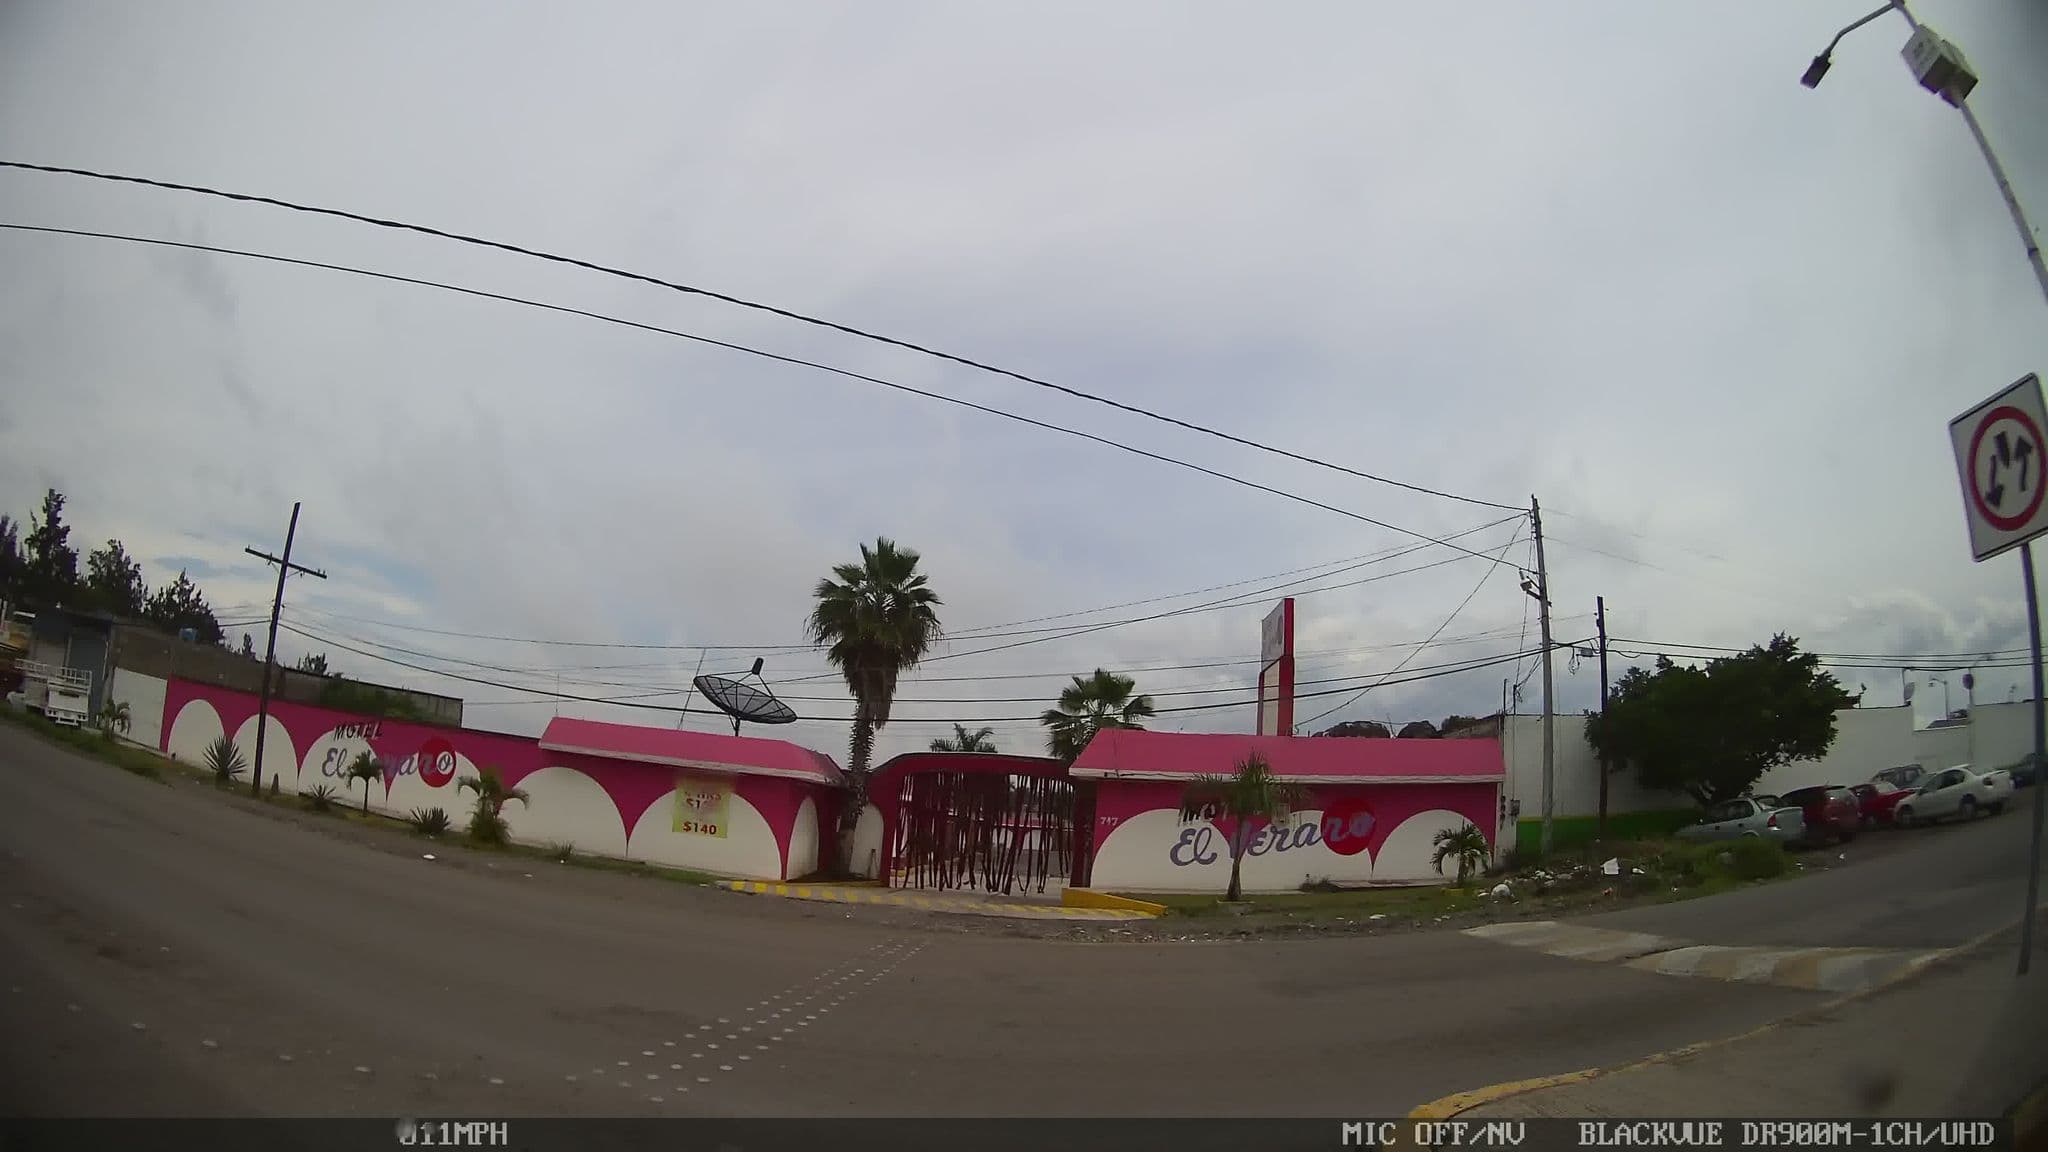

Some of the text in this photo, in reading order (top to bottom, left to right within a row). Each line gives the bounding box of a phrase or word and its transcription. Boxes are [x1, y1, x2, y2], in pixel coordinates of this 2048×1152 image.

[333, 721, 383, 741] MOTEL
[322, 748, 348, 778] El
[683, 821, 717, 835] $140
[1169, 827, 1218, 867] El
